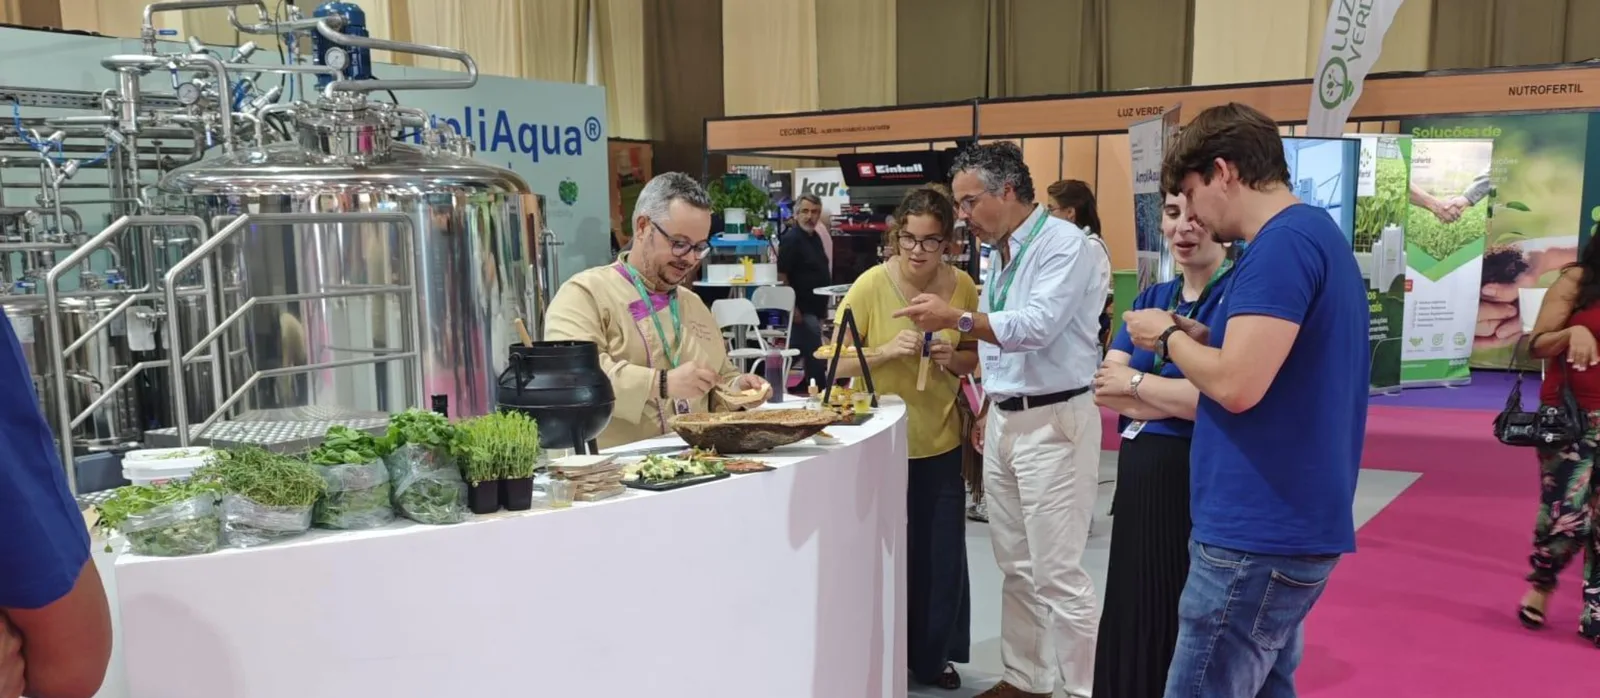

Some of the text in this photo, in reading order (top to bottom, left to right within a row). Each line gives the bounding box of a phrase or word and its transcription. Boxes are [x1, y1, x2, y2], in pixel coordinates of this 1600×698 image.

[1331, 0, 1356, 51] LUZ
[1508, 83, 1584, 96] NUTROFERTIL
[1117, 106, 1165, 118] LUZ VERDE
[1482, 125, 1502, 137] de
[875, 163, 923, 174] Einhell
